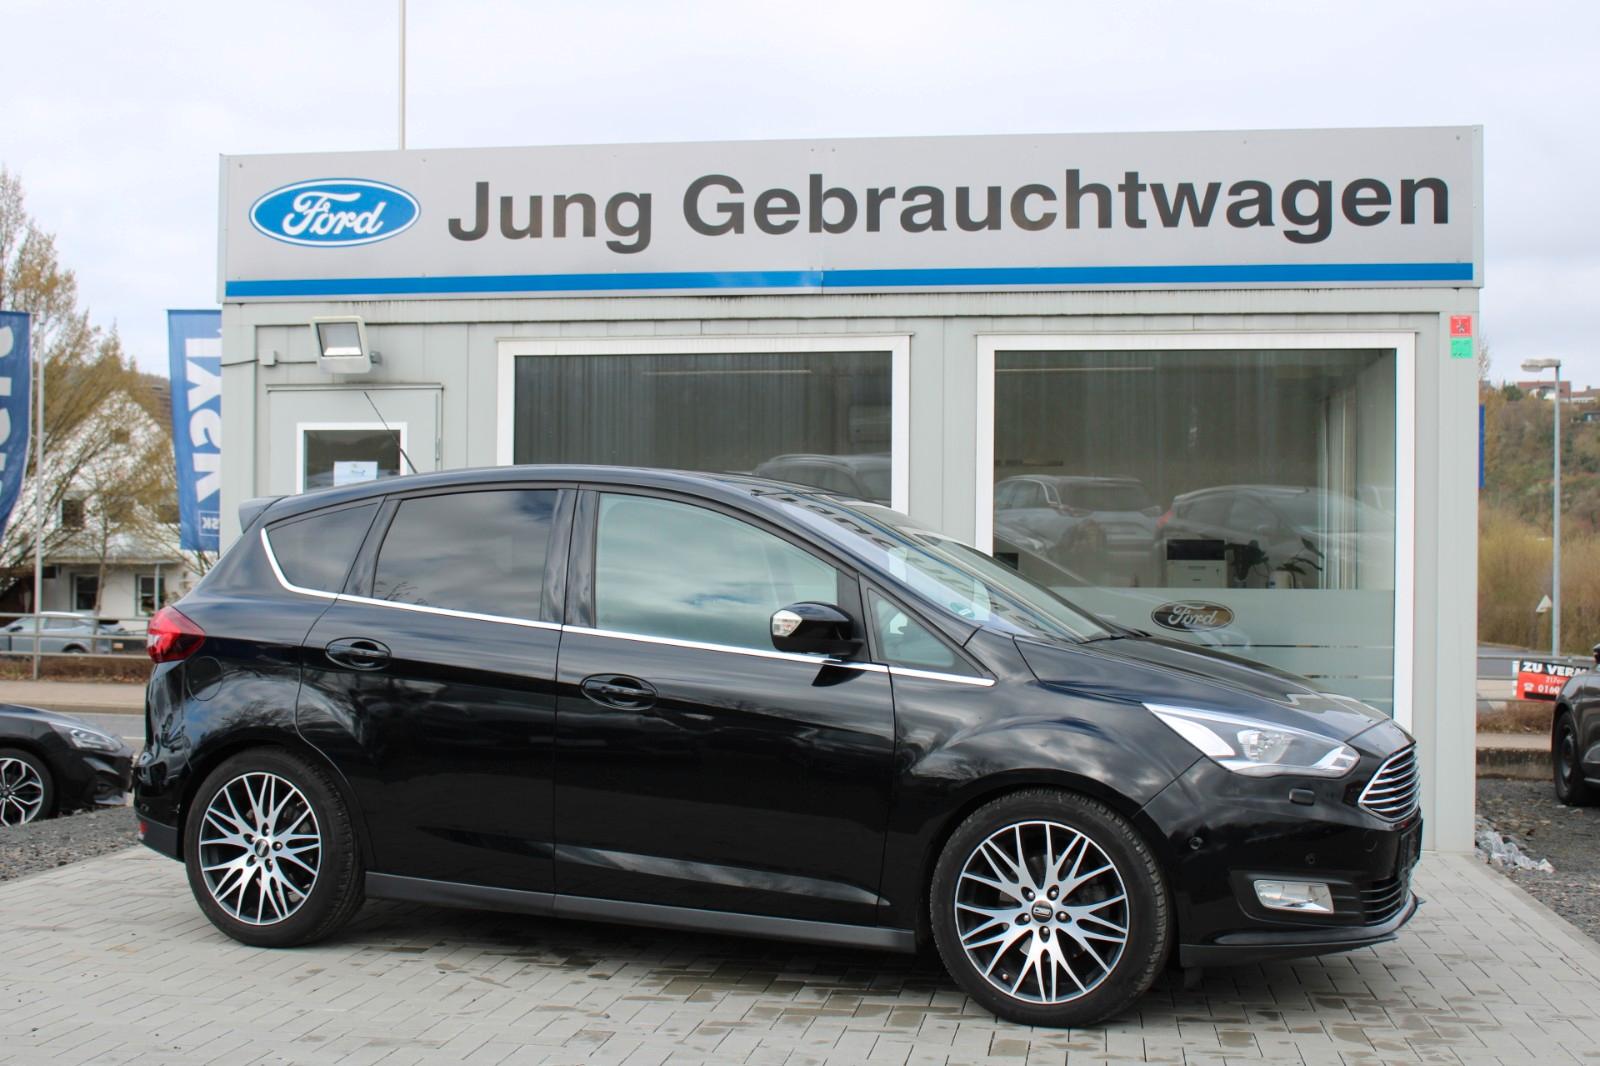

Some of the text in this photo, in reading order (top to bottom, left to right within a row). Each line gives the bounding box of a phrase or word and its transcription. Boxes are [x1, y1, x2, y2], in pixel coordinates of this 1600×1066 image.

[282, 191, 387, 236] Ford
[448, 168, 1449, 255] Jung Gebrauchtwagen
[1167, 604, 1218, 625] Ford
[1522, 661, 1587, 677] ZU VERM
